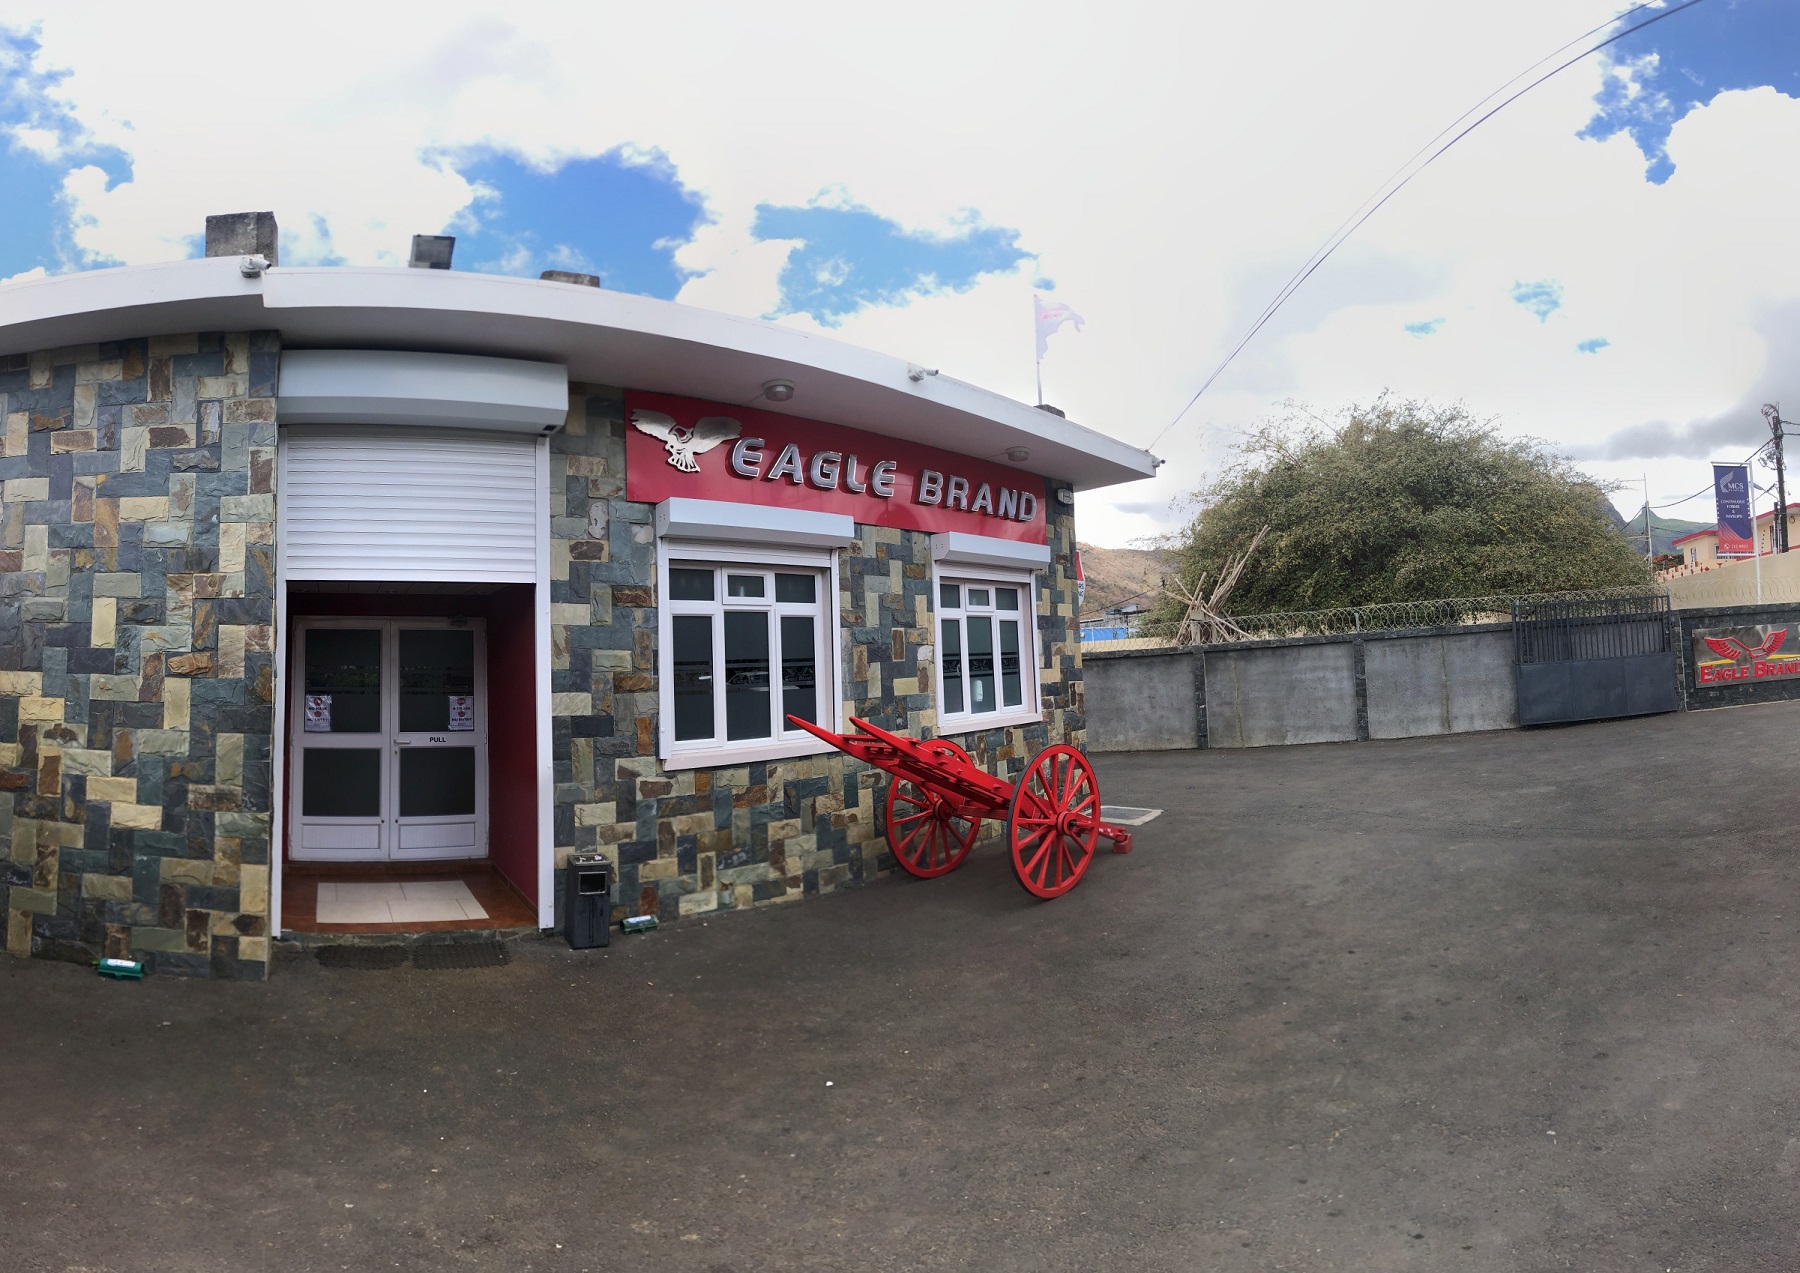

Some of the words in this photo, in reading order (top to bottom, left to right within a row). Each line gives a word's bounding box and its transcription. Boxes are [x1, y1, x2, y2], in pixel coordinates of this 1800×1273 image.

[732, 437, 897, 497] EAGLE
[919, 469, 1037, 521] BRAND
[1700, 664, 1749, 682] EAGLE
